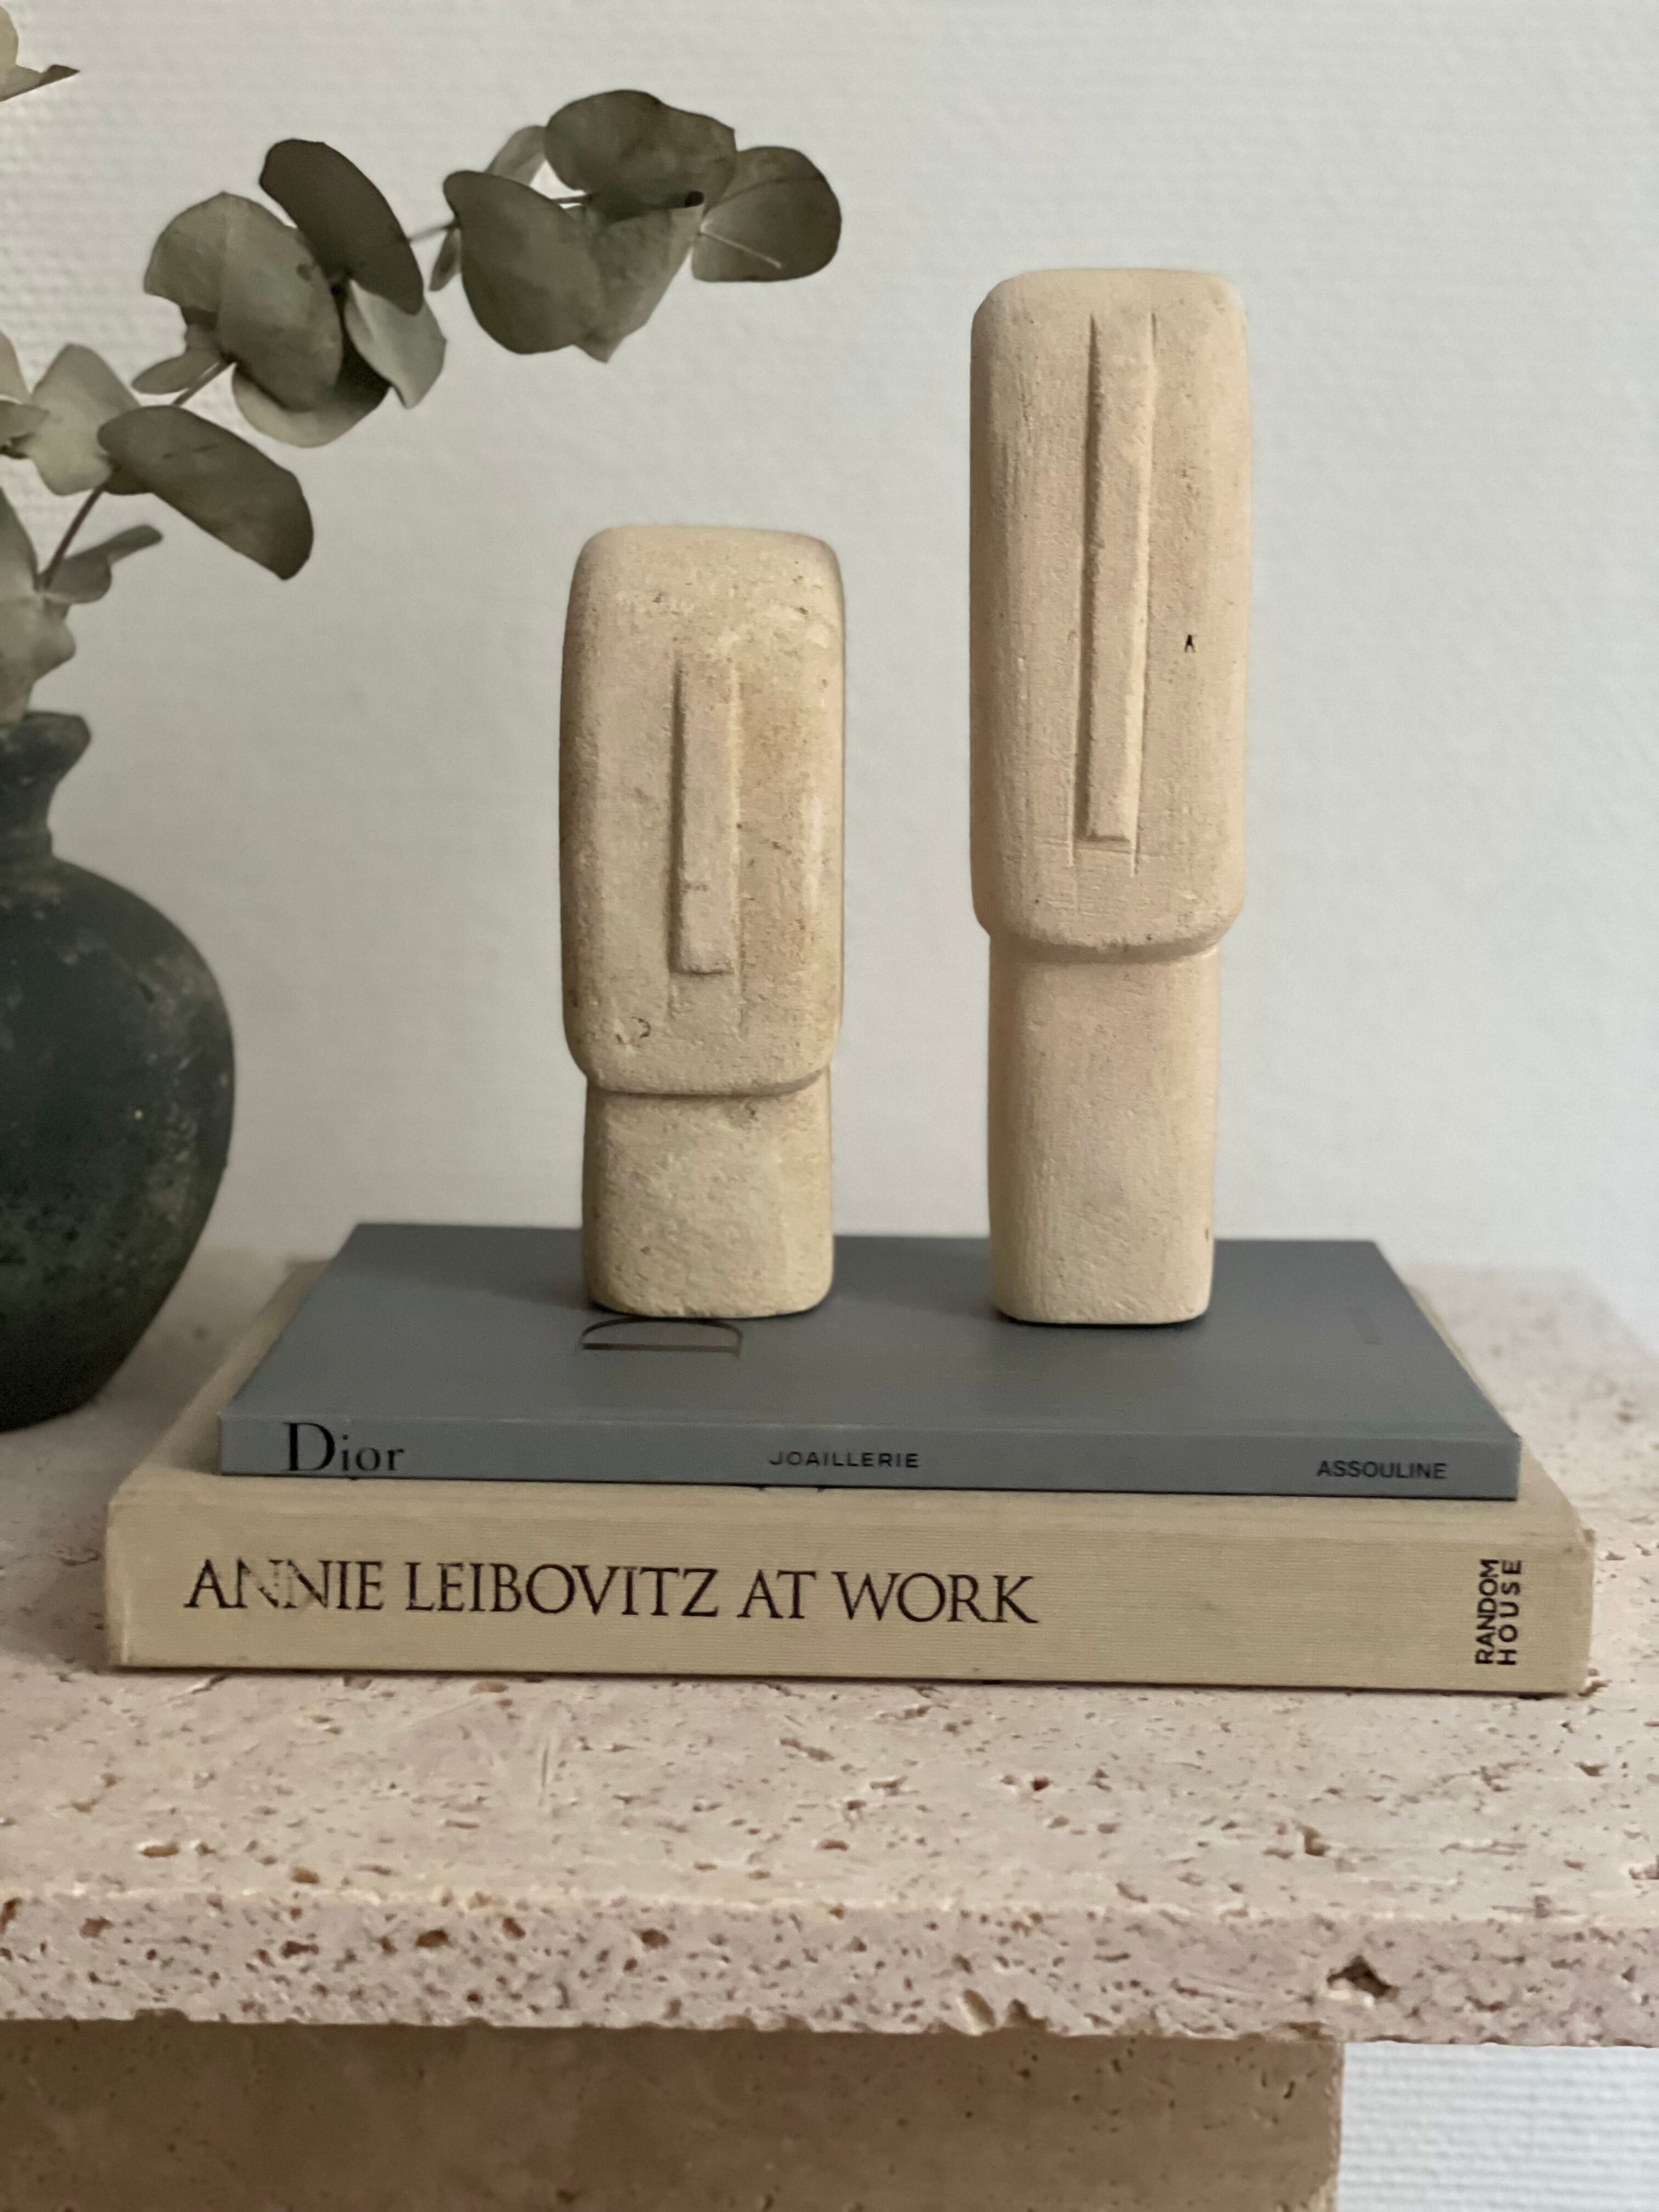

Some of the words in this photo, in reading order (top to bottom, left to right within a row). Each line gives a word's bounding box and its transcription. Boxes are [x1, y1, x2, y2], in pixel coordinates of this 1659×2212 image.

[285, 1422, 405, 1472] Dior
[770, 1451, 920, 1468] JOAILLERIE
[1317, 1460, 1448, 1480] ASSOULINE
[405, 1562, 719, 1618] LEIBOVITZ
[737, 1569, 817, 1620] AT
[831, 1571, 1039, 1623] WORK
[1475, 1559, 1499, 1665] RANDOM
[1497, 1560, 1522, 1666] HOUSE
